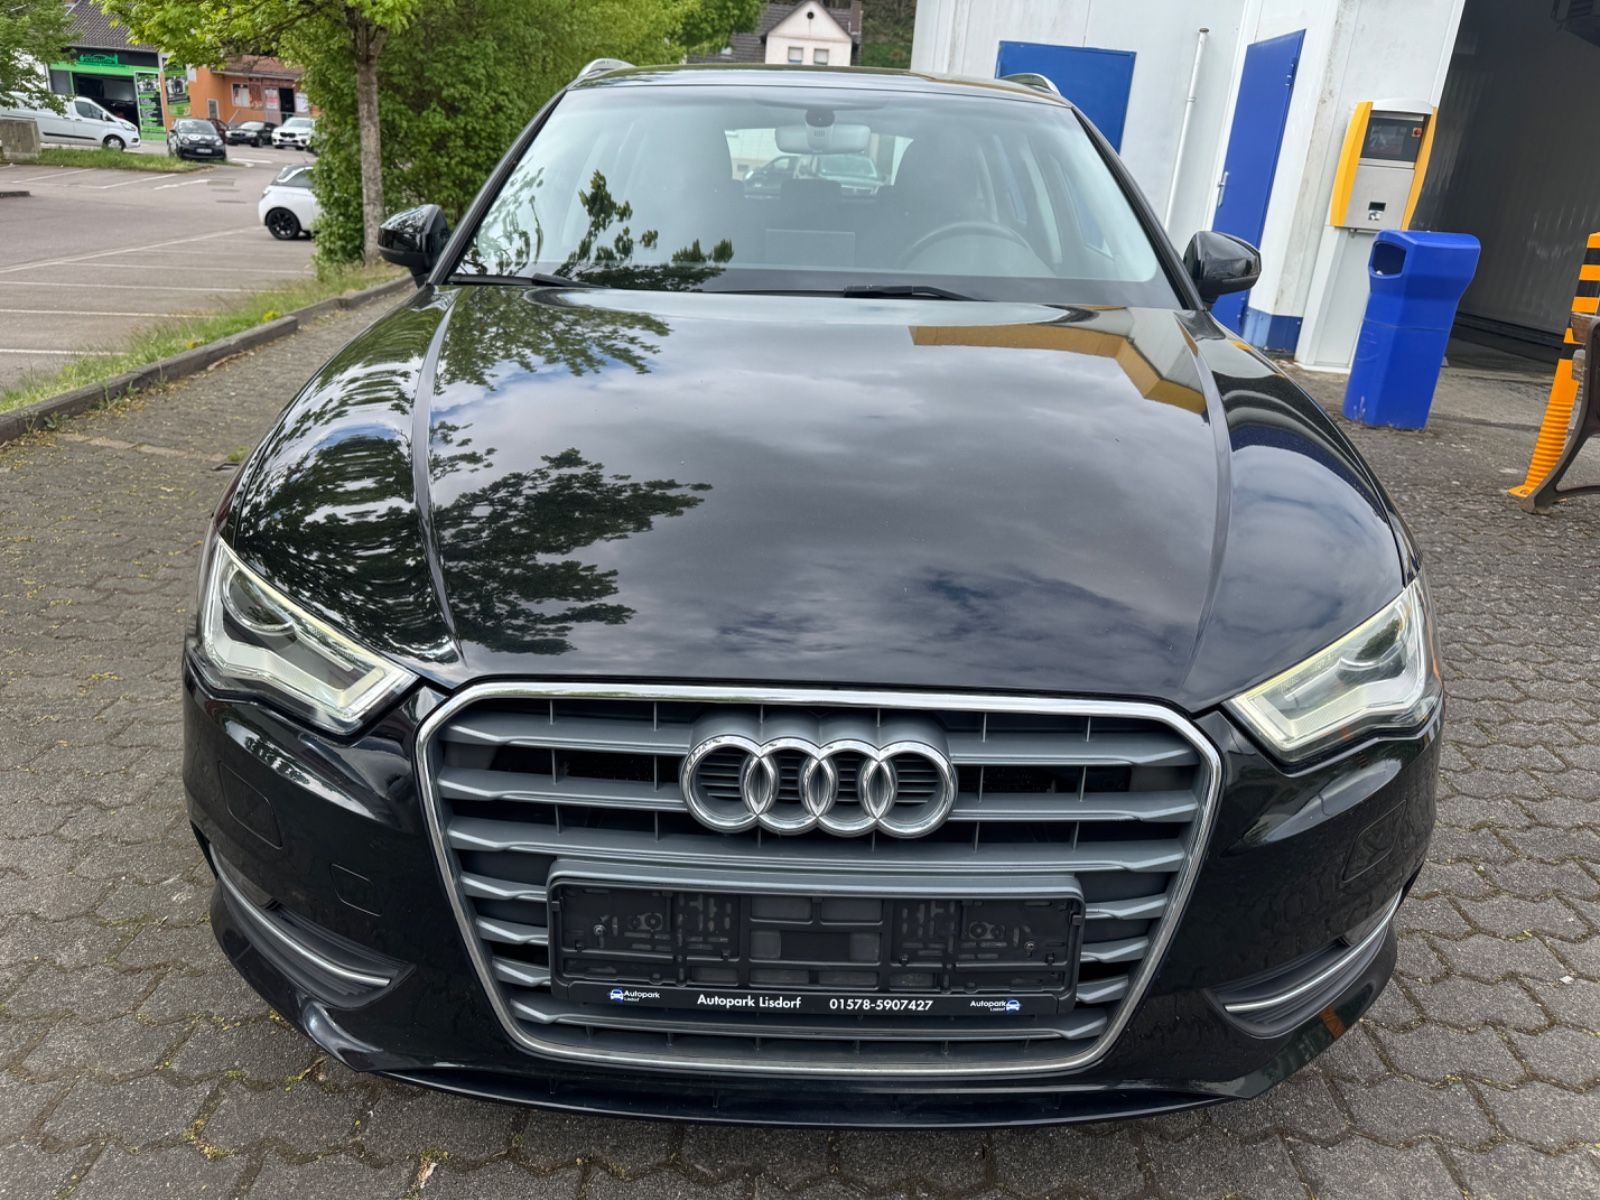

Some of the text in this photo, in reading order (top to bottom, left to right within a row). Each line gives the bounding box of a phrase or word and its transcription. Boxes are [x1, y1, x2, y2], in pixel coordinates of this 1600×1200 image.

[624, 990, 661, 999] Autopark
[697, 994, 933, 1011] Autopark Lisdorf 01578-5907427
[969, 1000, 1007, 1008] Autopark
